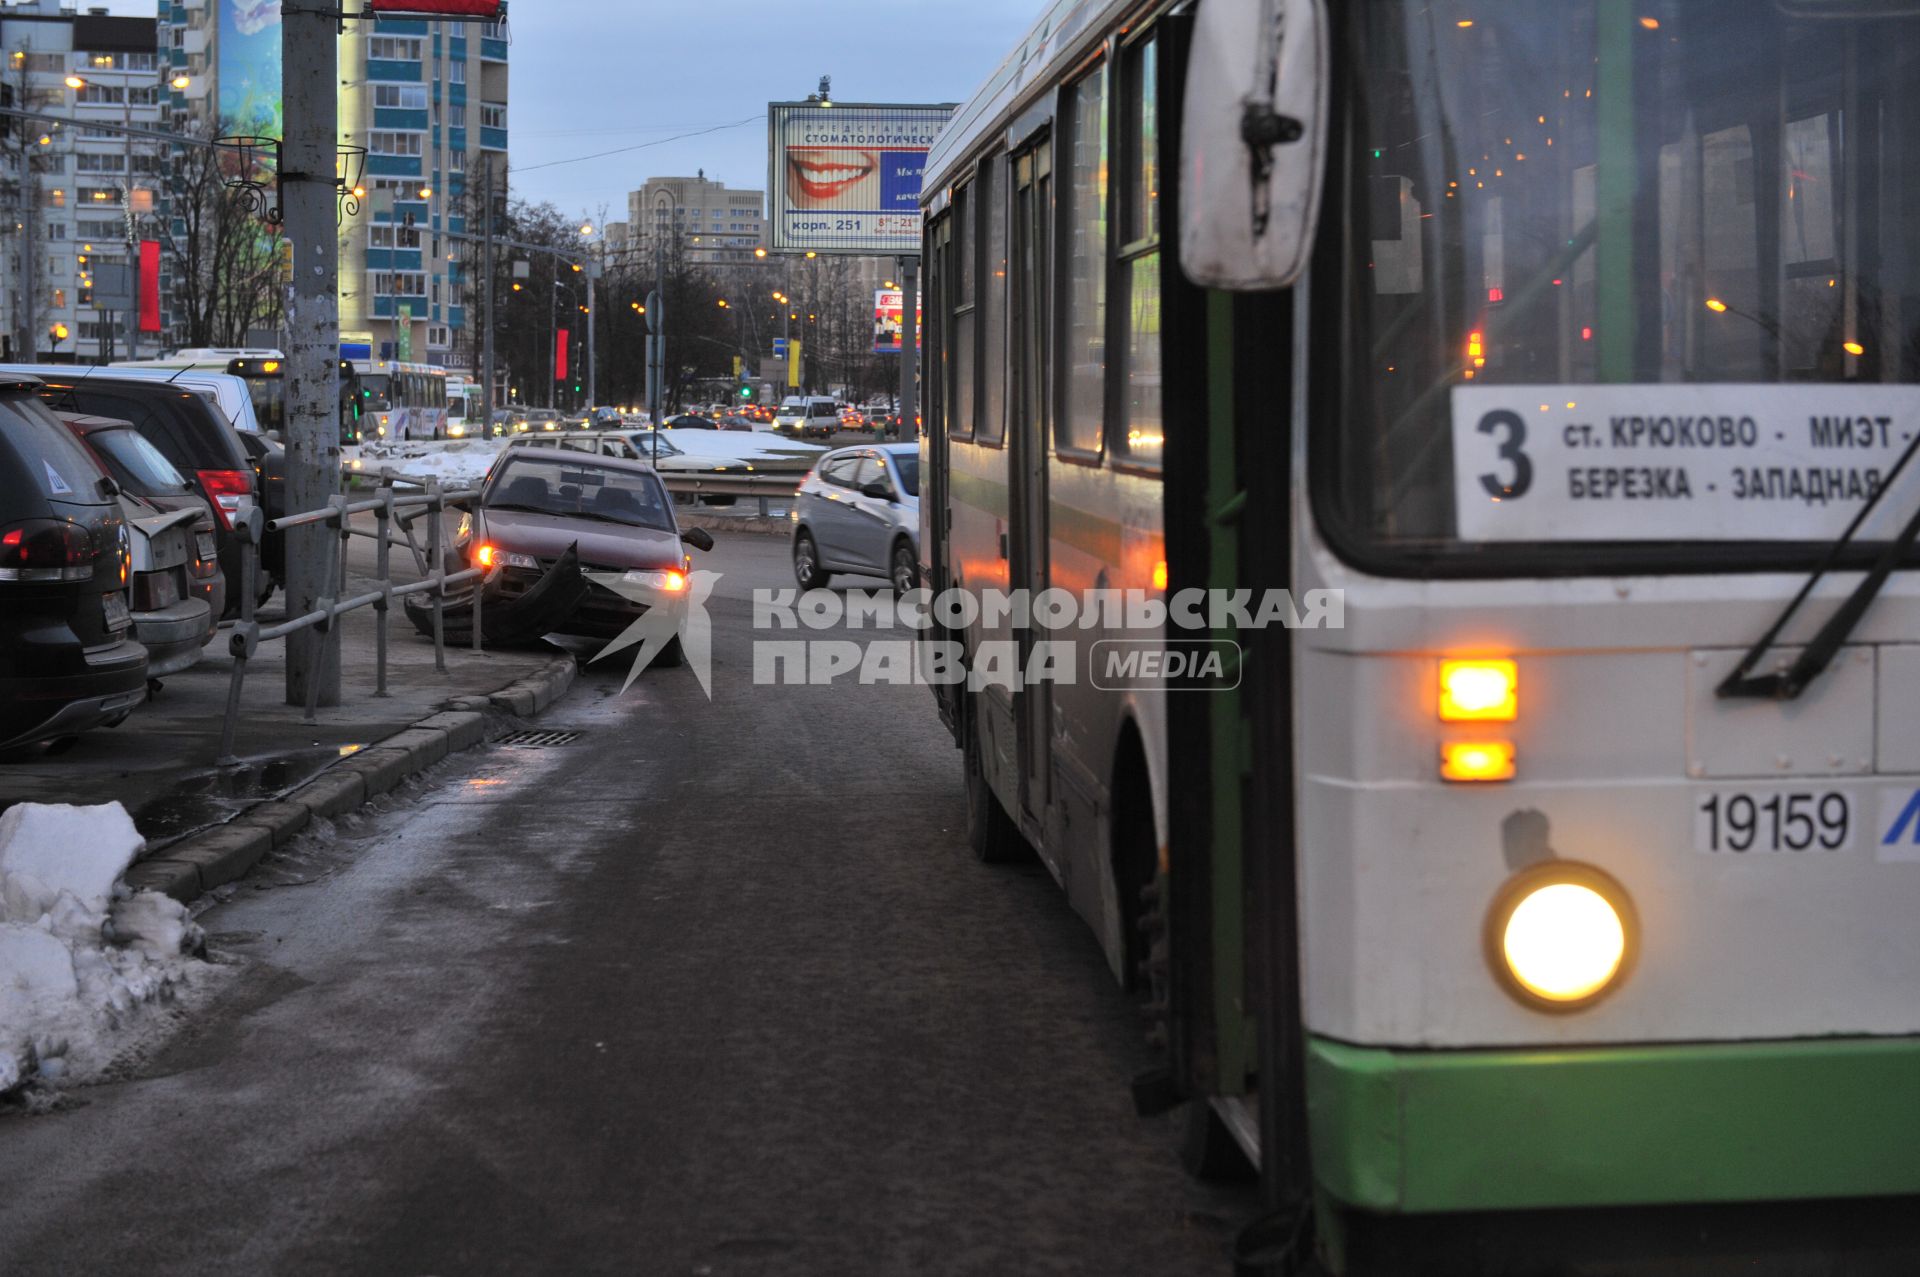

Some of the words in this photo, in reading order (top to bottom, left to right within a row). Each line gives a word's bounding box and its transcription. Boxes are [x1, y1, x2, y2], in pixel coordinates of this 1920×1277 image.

[805, 134, 934, 144] СТОМАТОЛОГИЧЕСК
[792, 222, 831, 232] корп.
[836, 220, 861, 230] 251
[1563, 424, 1602, 447] ст.
[1610, 416, 1758, 448] КРЮКОВО
[1810, 417, 1893, 448] МИЭТ
[1477, 409, 1533, 500] 3
[1569, 468, 1693, 499] БЕРЕЗКА
[1732, 468, 1882, 505] ЗАПАДНАЯ
[1701, 792, 1848, 851] 19159
